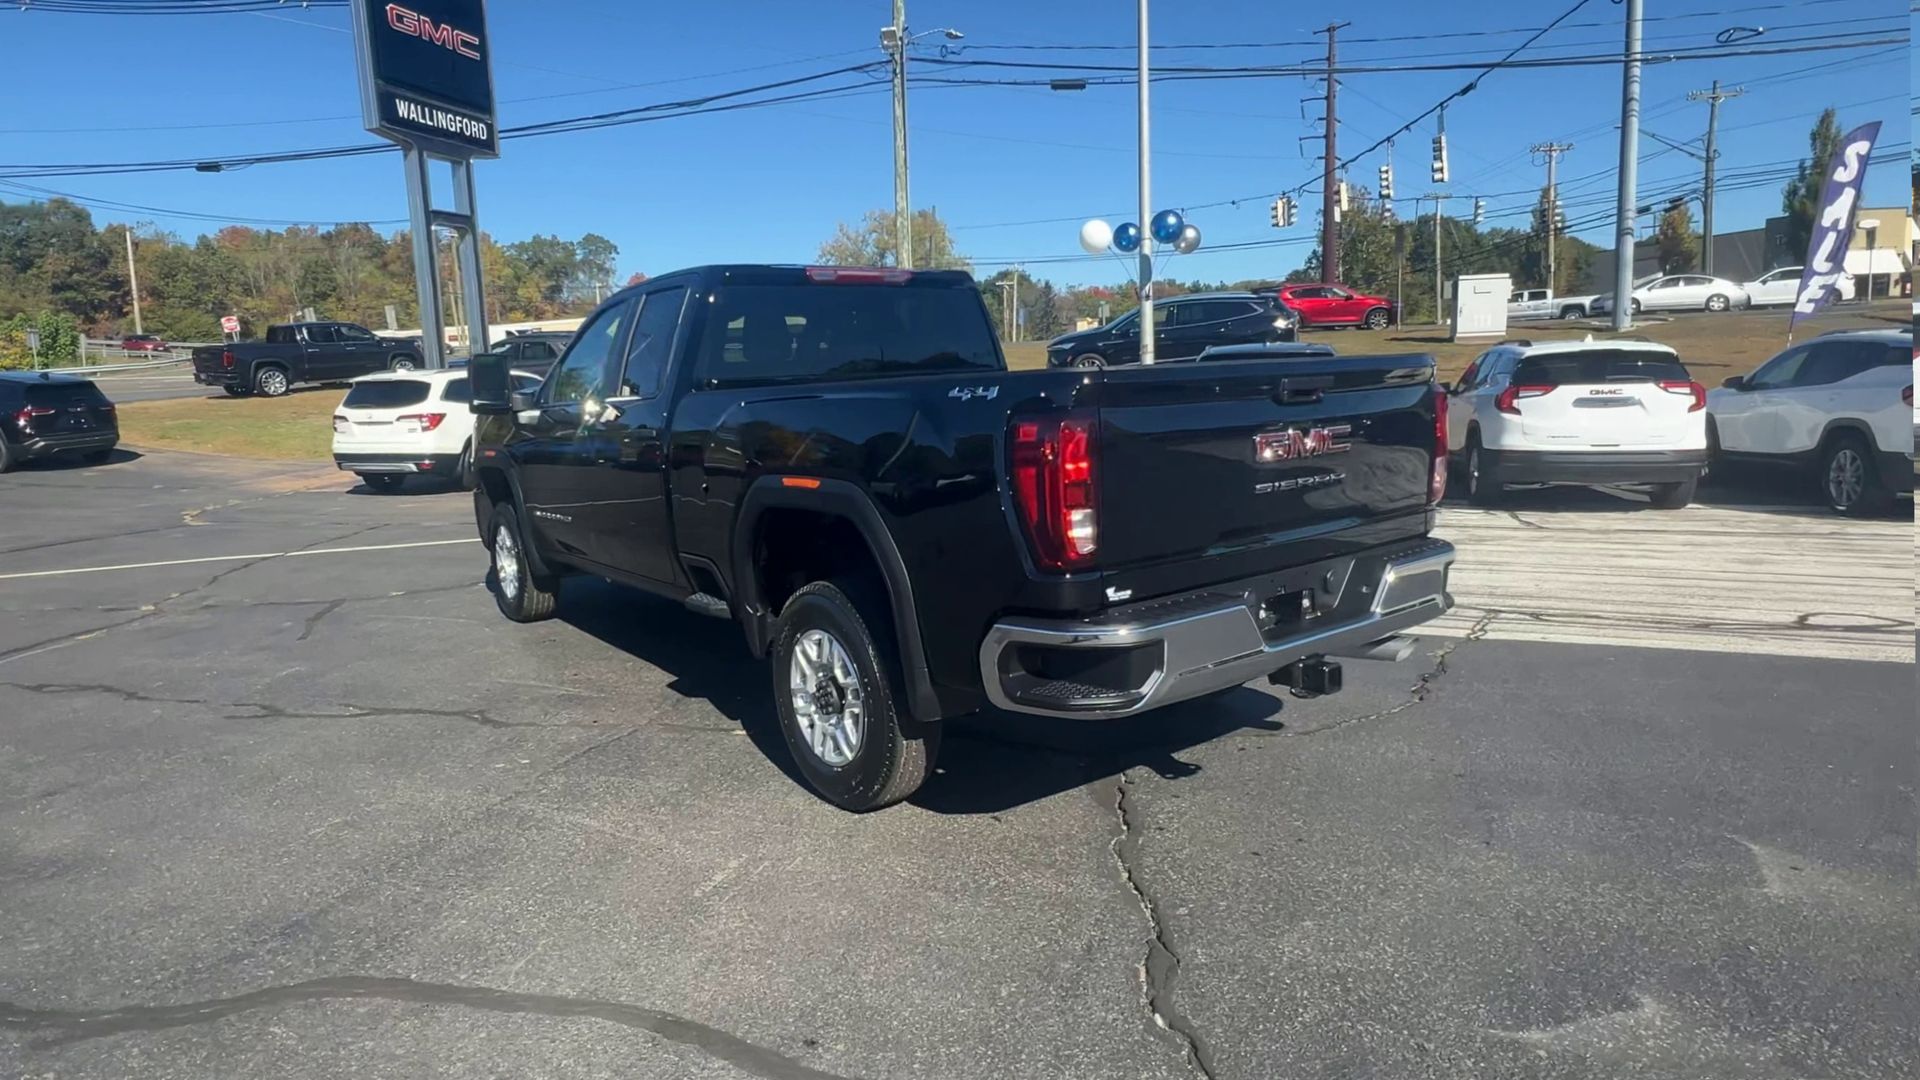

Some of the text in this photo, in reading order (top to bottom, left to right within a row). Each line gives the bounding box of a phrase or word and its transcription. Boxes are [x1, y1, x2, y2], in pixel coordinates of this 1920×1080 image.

[386, 3, 480, 60] GMC
[395, 98, 488, 140] WALLINGFORD
[1794, 140, 1871, 313] SALE
[1254, 424, 1352, 463] GMC
